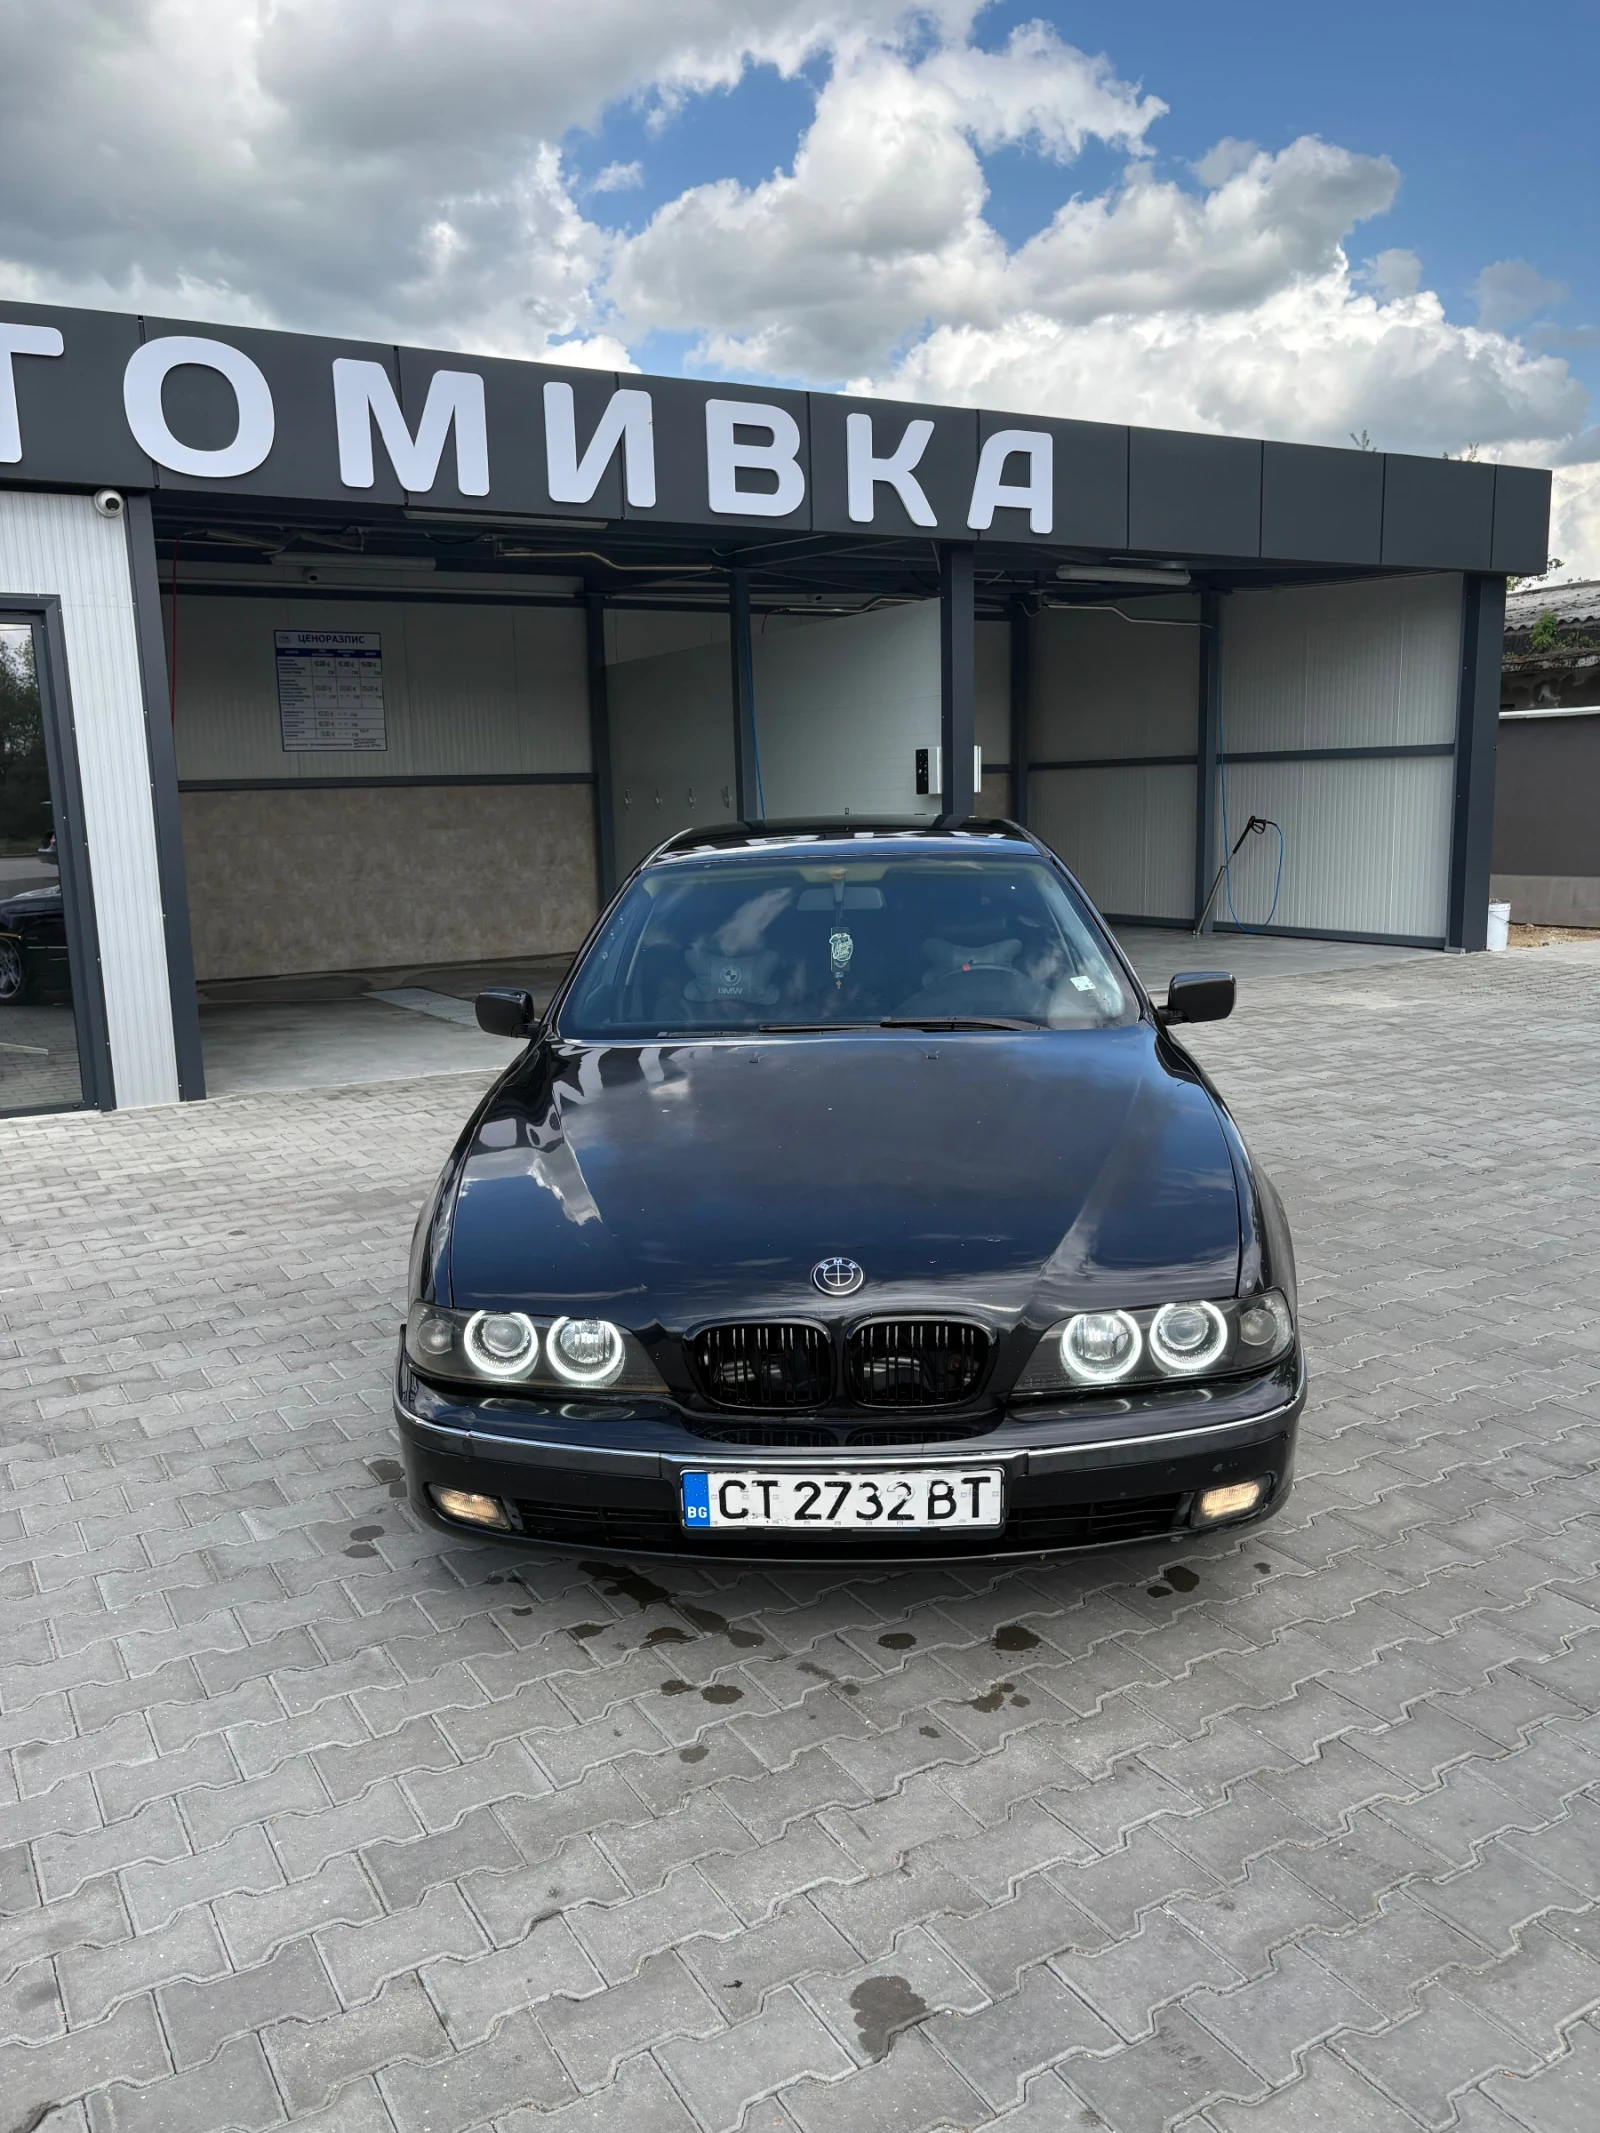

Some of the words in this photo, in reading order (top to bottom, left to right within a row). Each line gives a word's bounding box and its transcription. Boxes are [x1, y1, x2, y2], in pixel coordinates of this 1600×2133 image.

[297, 633, 366, 645] ЦЕНОРАЗПИС
[717, 986, 743, 995] BMW
[819, 1258, 858, 1270] BMW
[718, 1479, 781, 1519] CT
[793, 1479, 916, 1521] 2732
[926, 1476, 991, 1520] BT
[687, 1506, 708, 1519] BG
